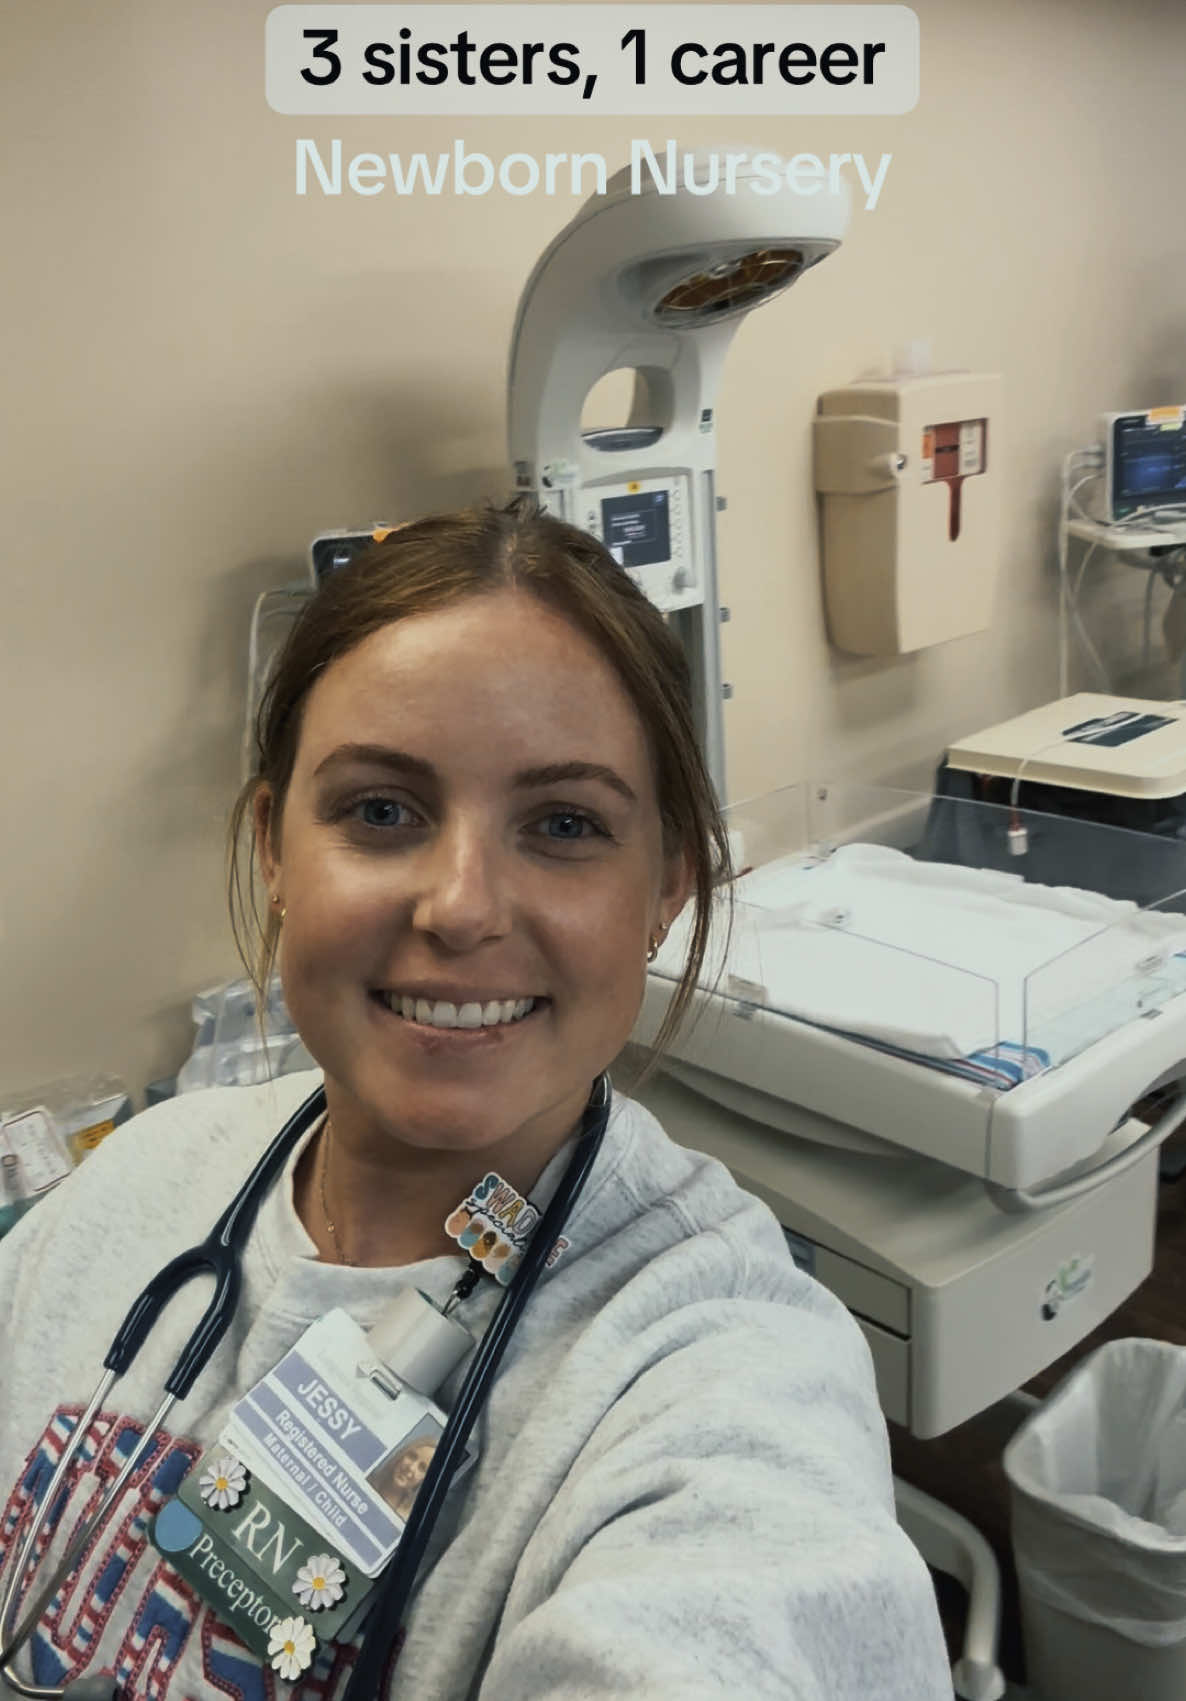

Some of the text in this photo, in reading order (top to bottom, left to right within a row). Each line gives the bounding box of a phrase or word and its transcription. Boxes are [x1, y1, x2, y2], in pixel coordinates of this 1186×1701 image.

[473, 1174, 569, 1267] SWADE
[297, 1378, 362, 1440] JESSY
[263, 1432, 311, 1486] Maternal
[315, 1491, 347, 1528] Child
[275, 1409, 369, 1515] Registered Nurse
[189, 1533, 282, 1634] Preceptor
[231, 1501, 303, 1575] RN
